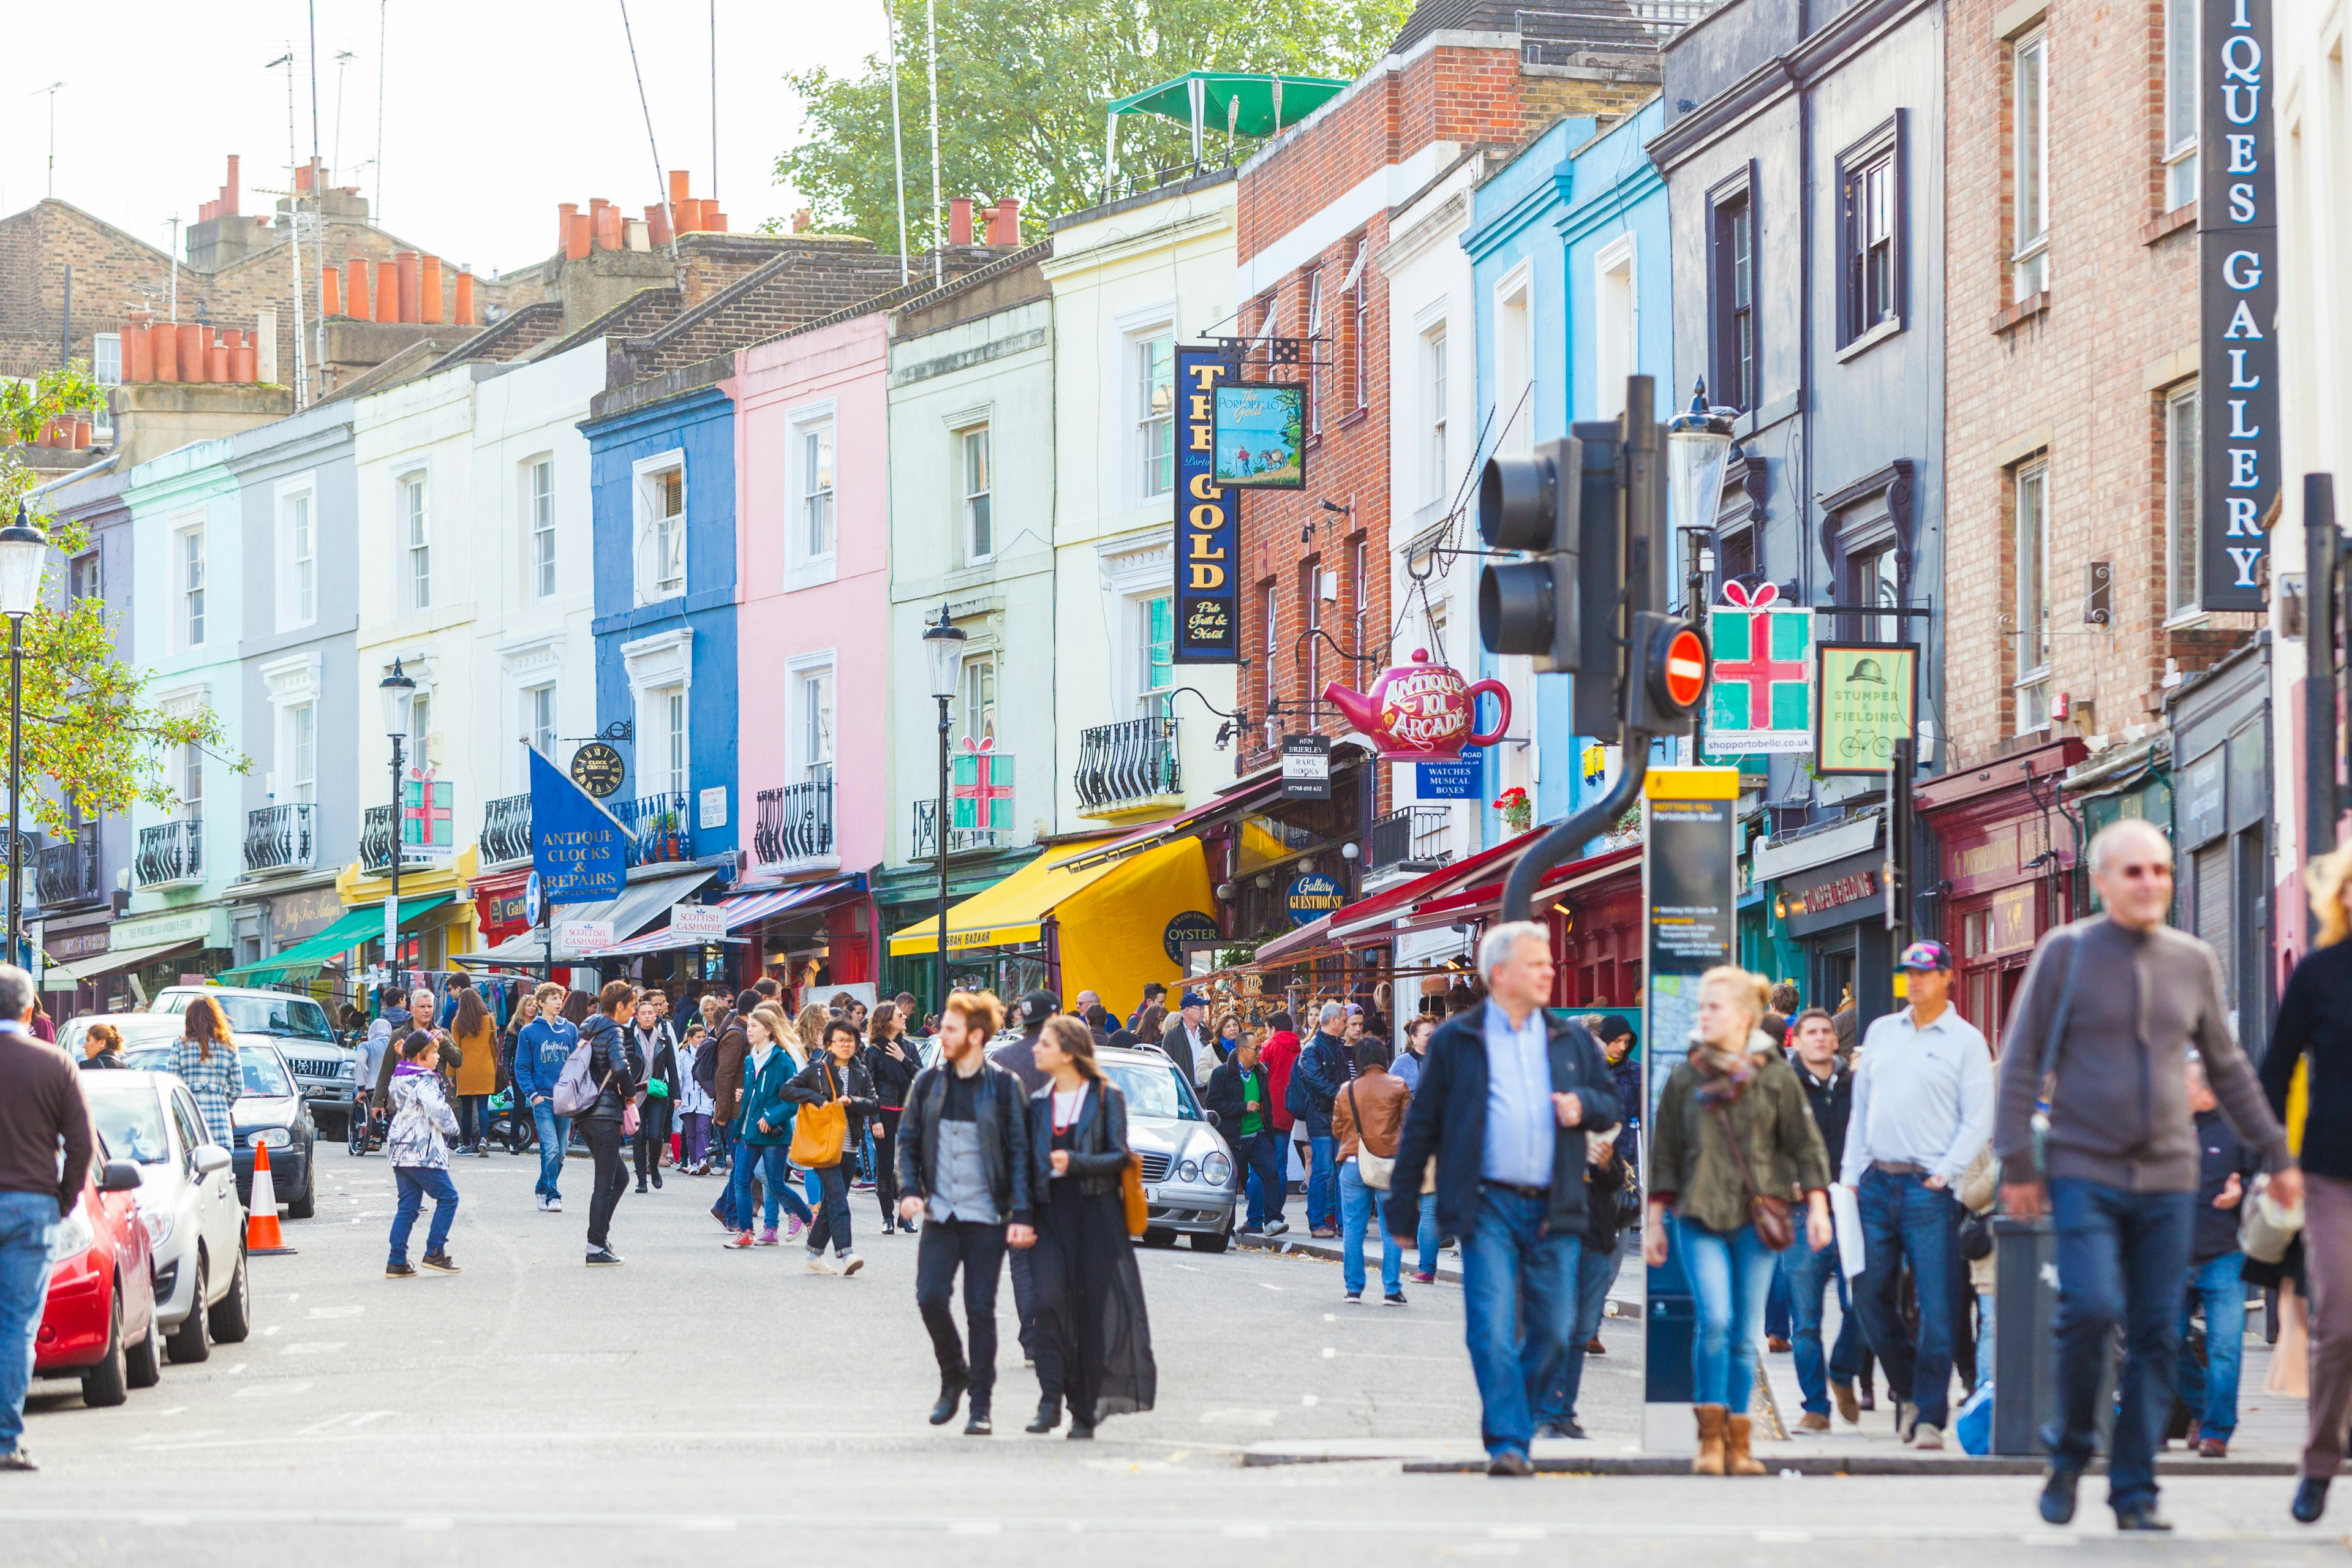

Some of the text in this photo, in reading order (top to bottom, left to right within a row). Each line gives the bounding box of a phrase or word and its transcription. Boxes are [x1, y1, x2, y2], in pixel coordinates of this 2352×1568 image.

[1243, 390, 1259, 404] The
[1234, 404, 1264, 424] Gold
[2223, 251, 2264, 588] GALLERY
[1184, 455, 1210, 466] Porto
[1189, 473, 1224, 589] GOLD
[1196, 601, 1221, 612] Pub
[1188, 614, 1228, 628] Grill &
[1191, 627, 1225, 639] Hotel
[1381, 670, 1466, 714] ANTIQUE
[1834, 691, 1899, 701] STUMPER
[1421, 694, 1449, 717] 101
[1834, 712, 1899, 722] FIELDING
[1389, 706, 1468, 744] ARCADE
[1709, 738, 1809, 750] shopportobello.co.uk
[701, 804, 726, 815] PORTOBELLO
[703, 816, 714, 826] ROAD
[543, 830, 614, 845] ANTIQUE
[548, 846, 610, 862] CLOCKS
[574, 862, 586, 872] &
[547, 872, 616, 888] REPAIRS
[1298, 877, 1335, 899] Gallery
[1290, 895, 1343, 909] GUESTHOUSE
[680, 913, 718, 922] SCOTTISH
[677, 923, 722, 932] CASHMERE
[1169, 929, 1216, 940] OYSTER
[937, 931, 990, 948] SBAH BAZAAR
